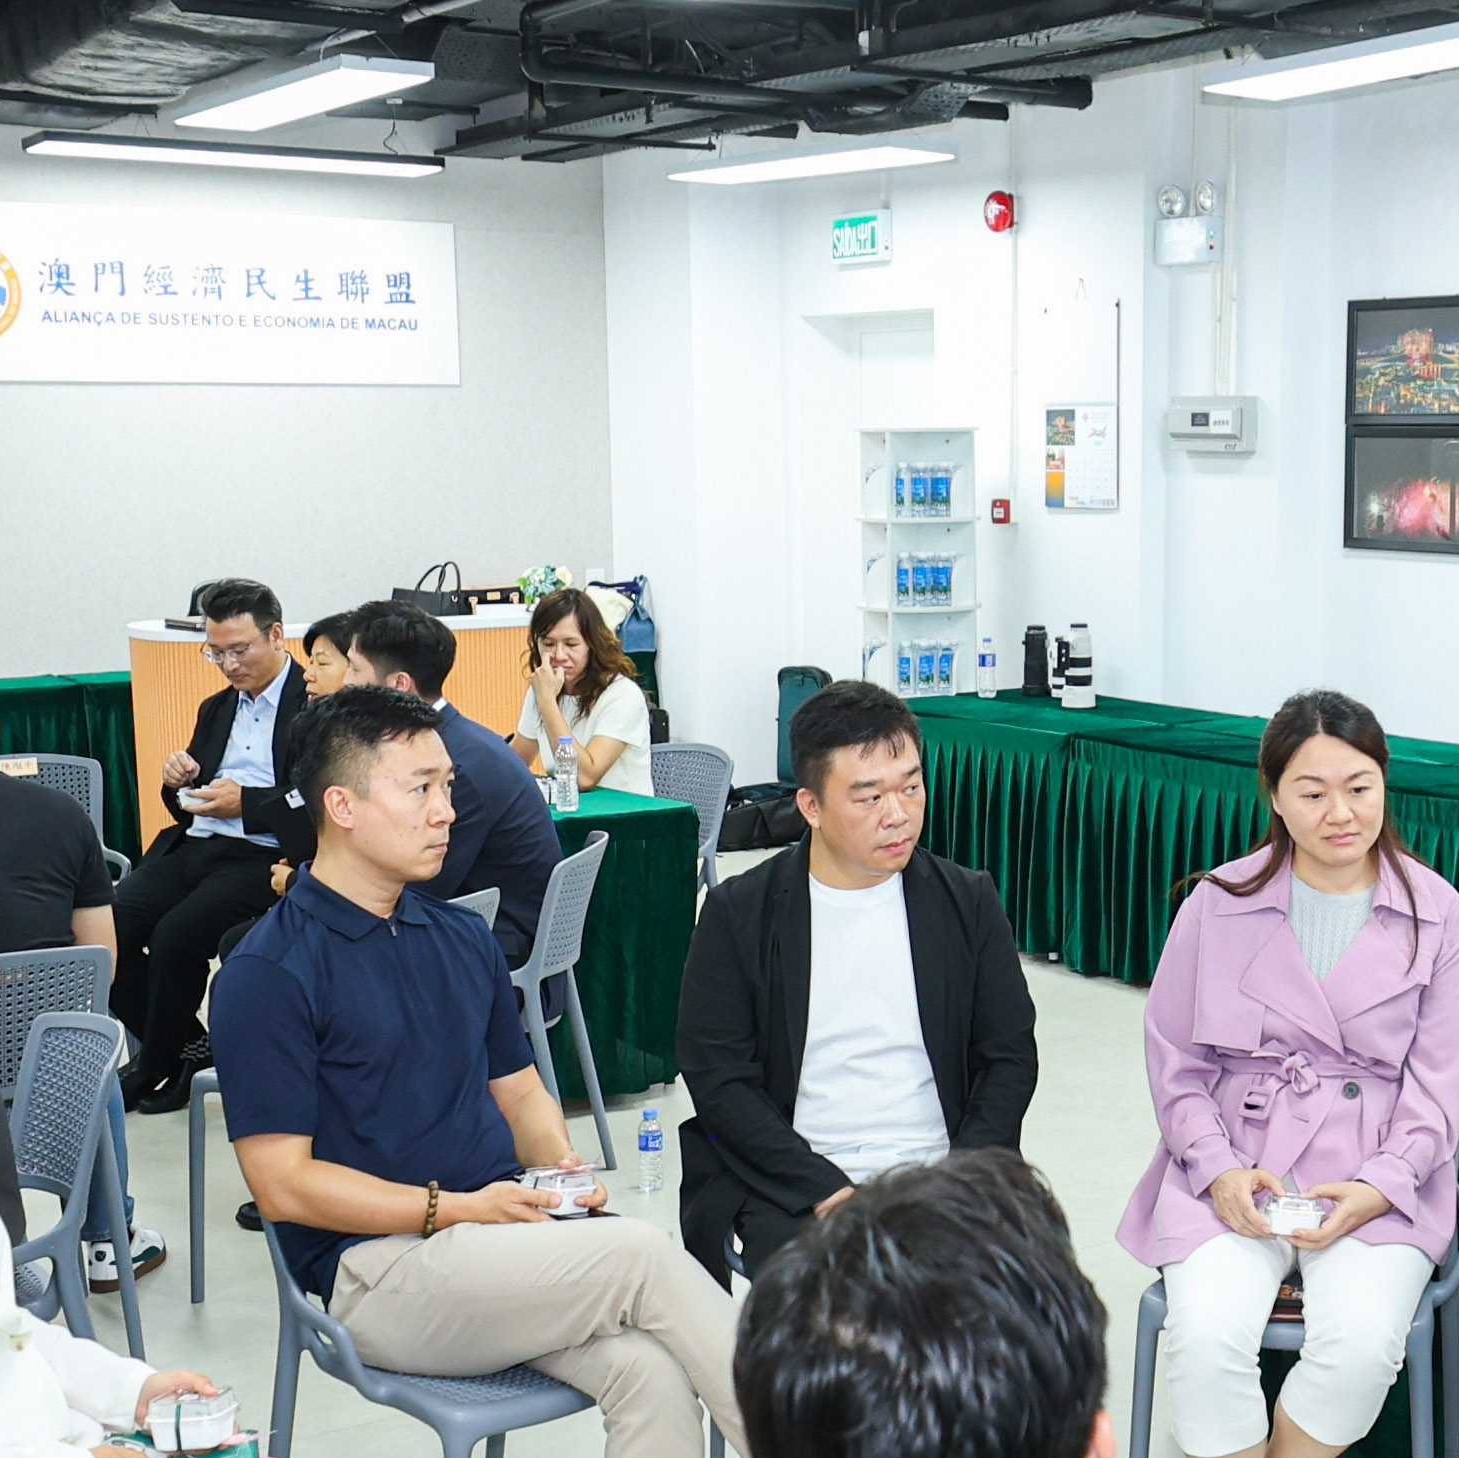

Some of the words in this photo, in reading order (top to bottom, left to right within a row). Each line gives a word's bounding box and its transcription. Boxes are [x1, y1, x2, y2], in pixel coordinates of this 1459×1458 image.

[833, 220, 857, 257] SAÍDA
[856, 220, 878, 254] 出口
[38, 257, 416, 304] 澳門經濟民生聯盟
[41, 309, 116, 327] ALIANÇA
[121, 312, 142, 325] DE
[148, 312, 234, 327] SUSTENTO
[239, 315, 248, 328] E
[253, 315, 335, 329] ECONOMIA
[340, 317, 360, 330] DE
[364, 317, 418, 331] MACAU
